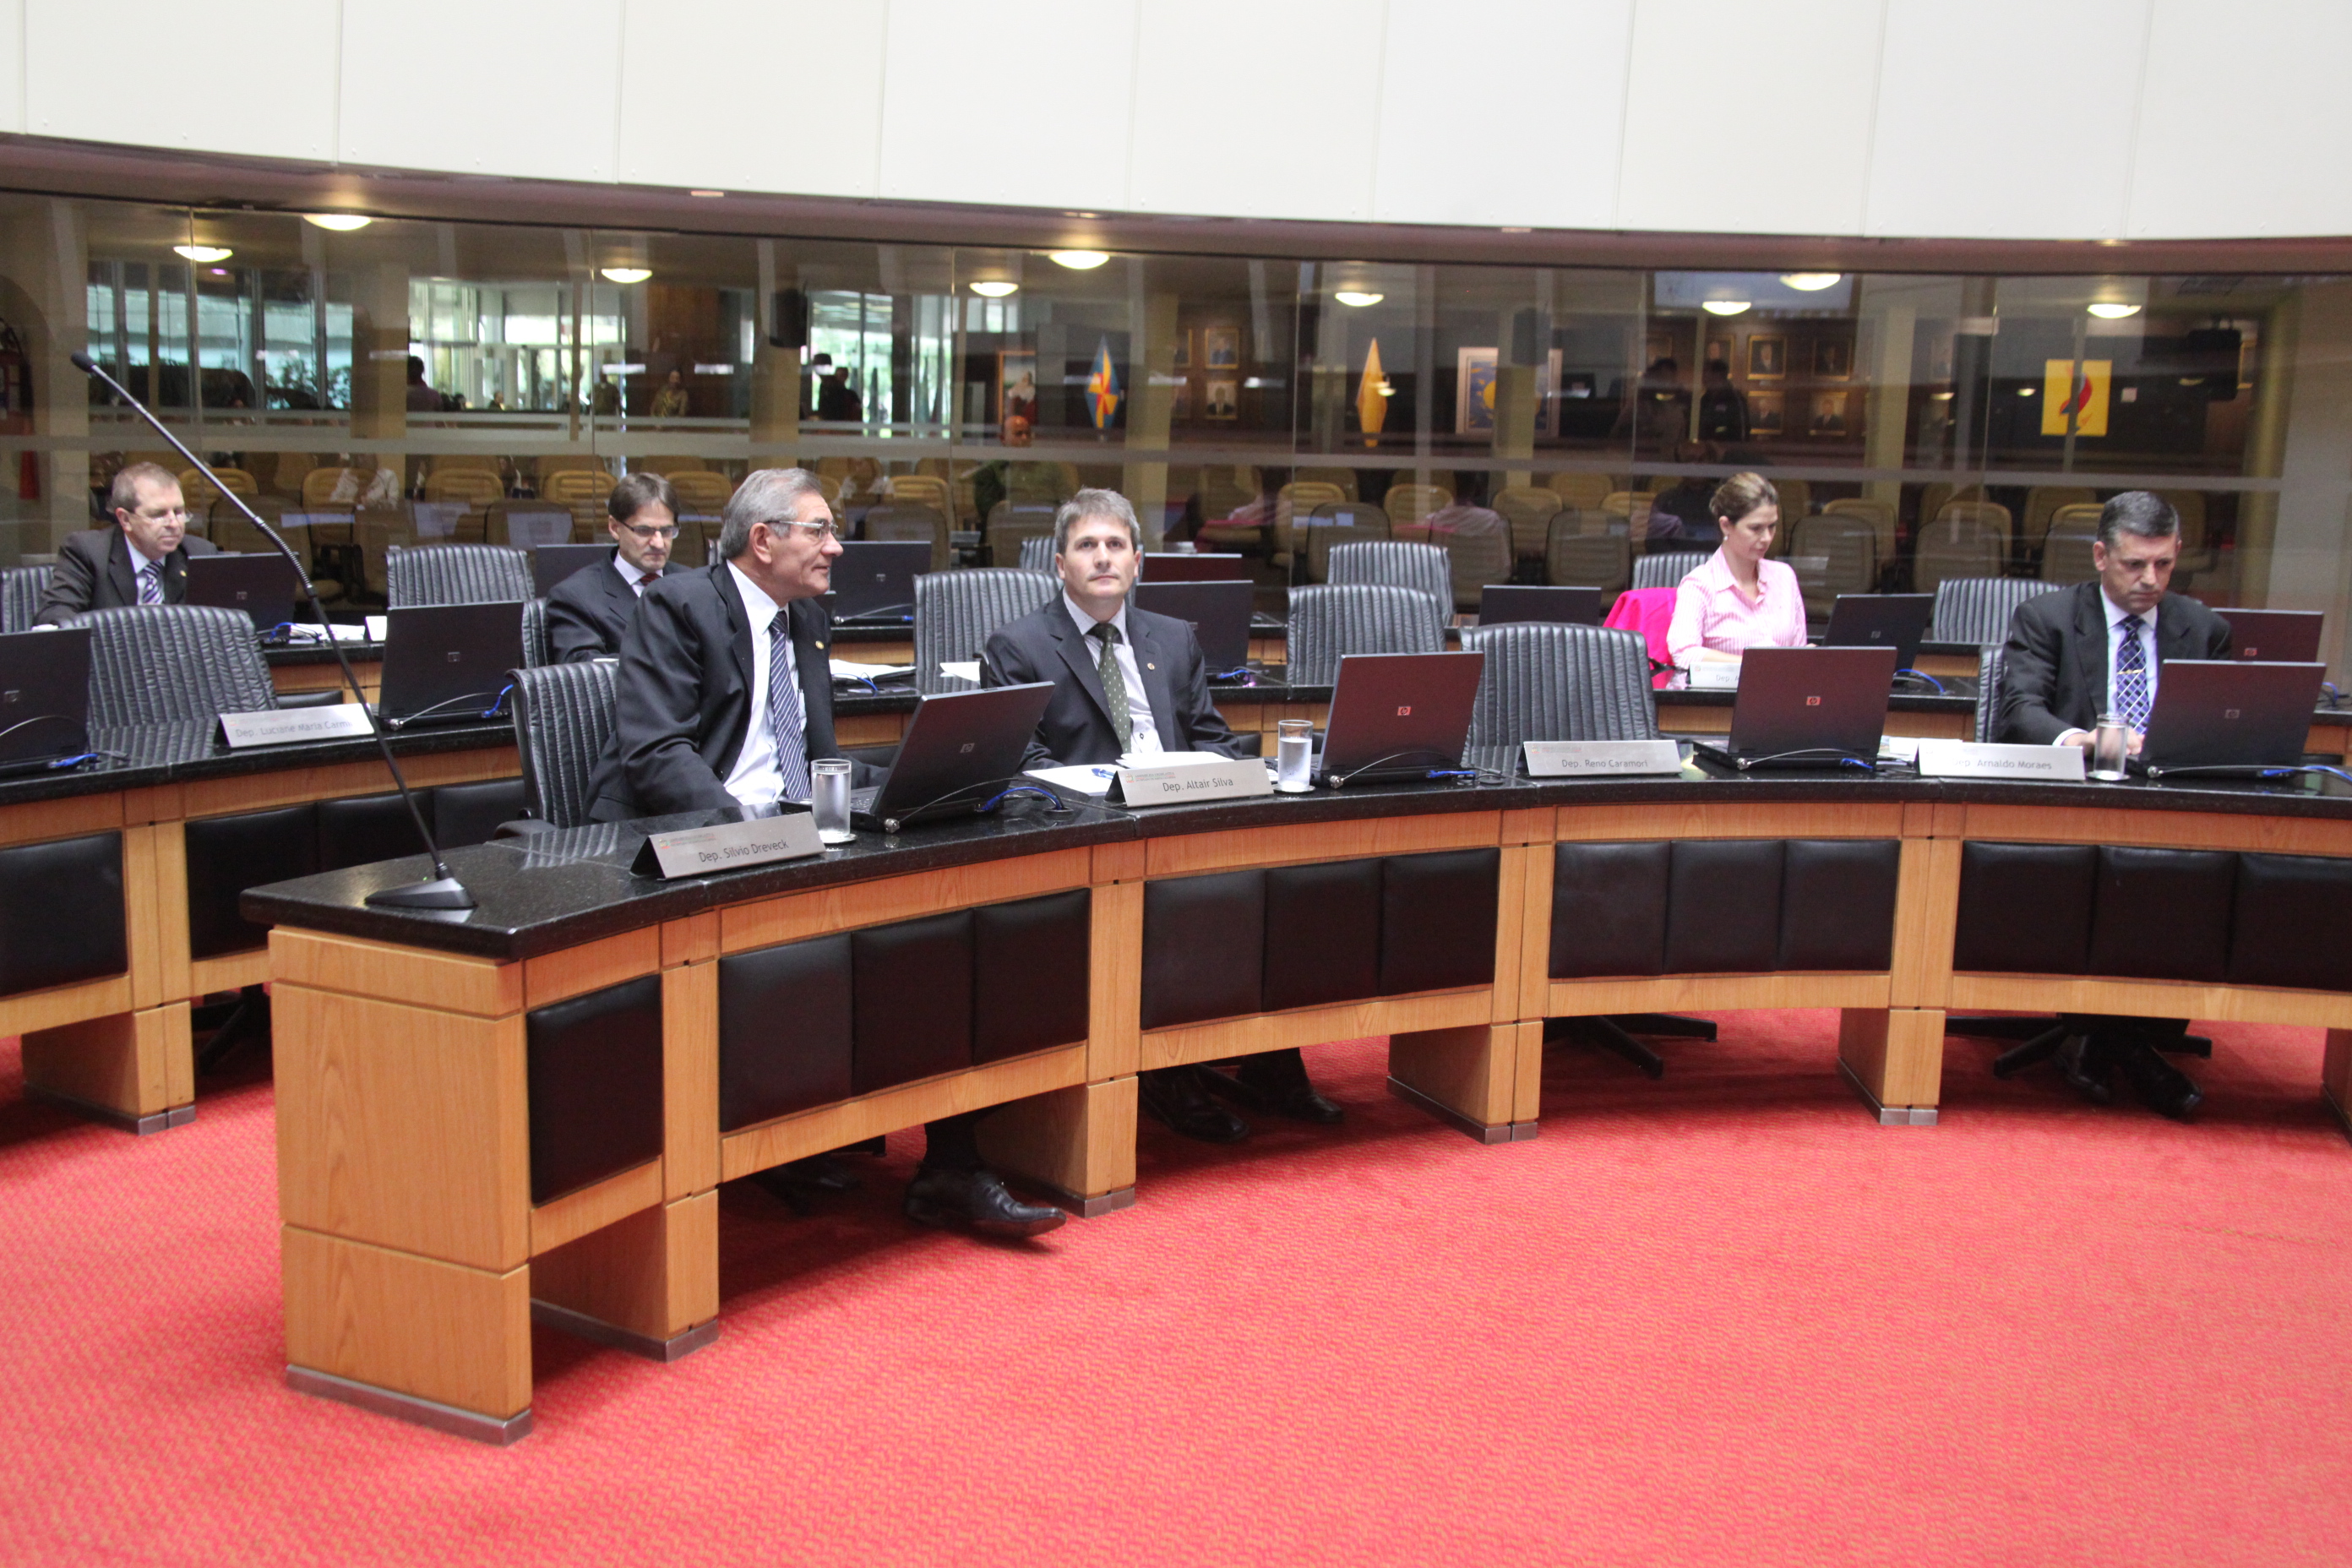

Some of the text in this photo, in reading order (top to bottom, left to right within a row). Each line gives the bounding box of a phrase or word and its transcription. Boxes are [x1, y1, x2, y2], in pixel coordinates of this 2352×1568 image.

[298, 721, 323, 732] Maria
[1562, 759, 1648, 768] Dep. Reno Caramori
[1977, 759, 2015, 768] Arnaldo
[2017, 760, 2052, 770] Moraes
[1162, 781, 1184, 793] Dep.
[1186, 779, 1211, 790] Altair
[1212, 777, 1234, 787] Silva
[698, 839, 790, 863] Dep. Silvio Dreveck
